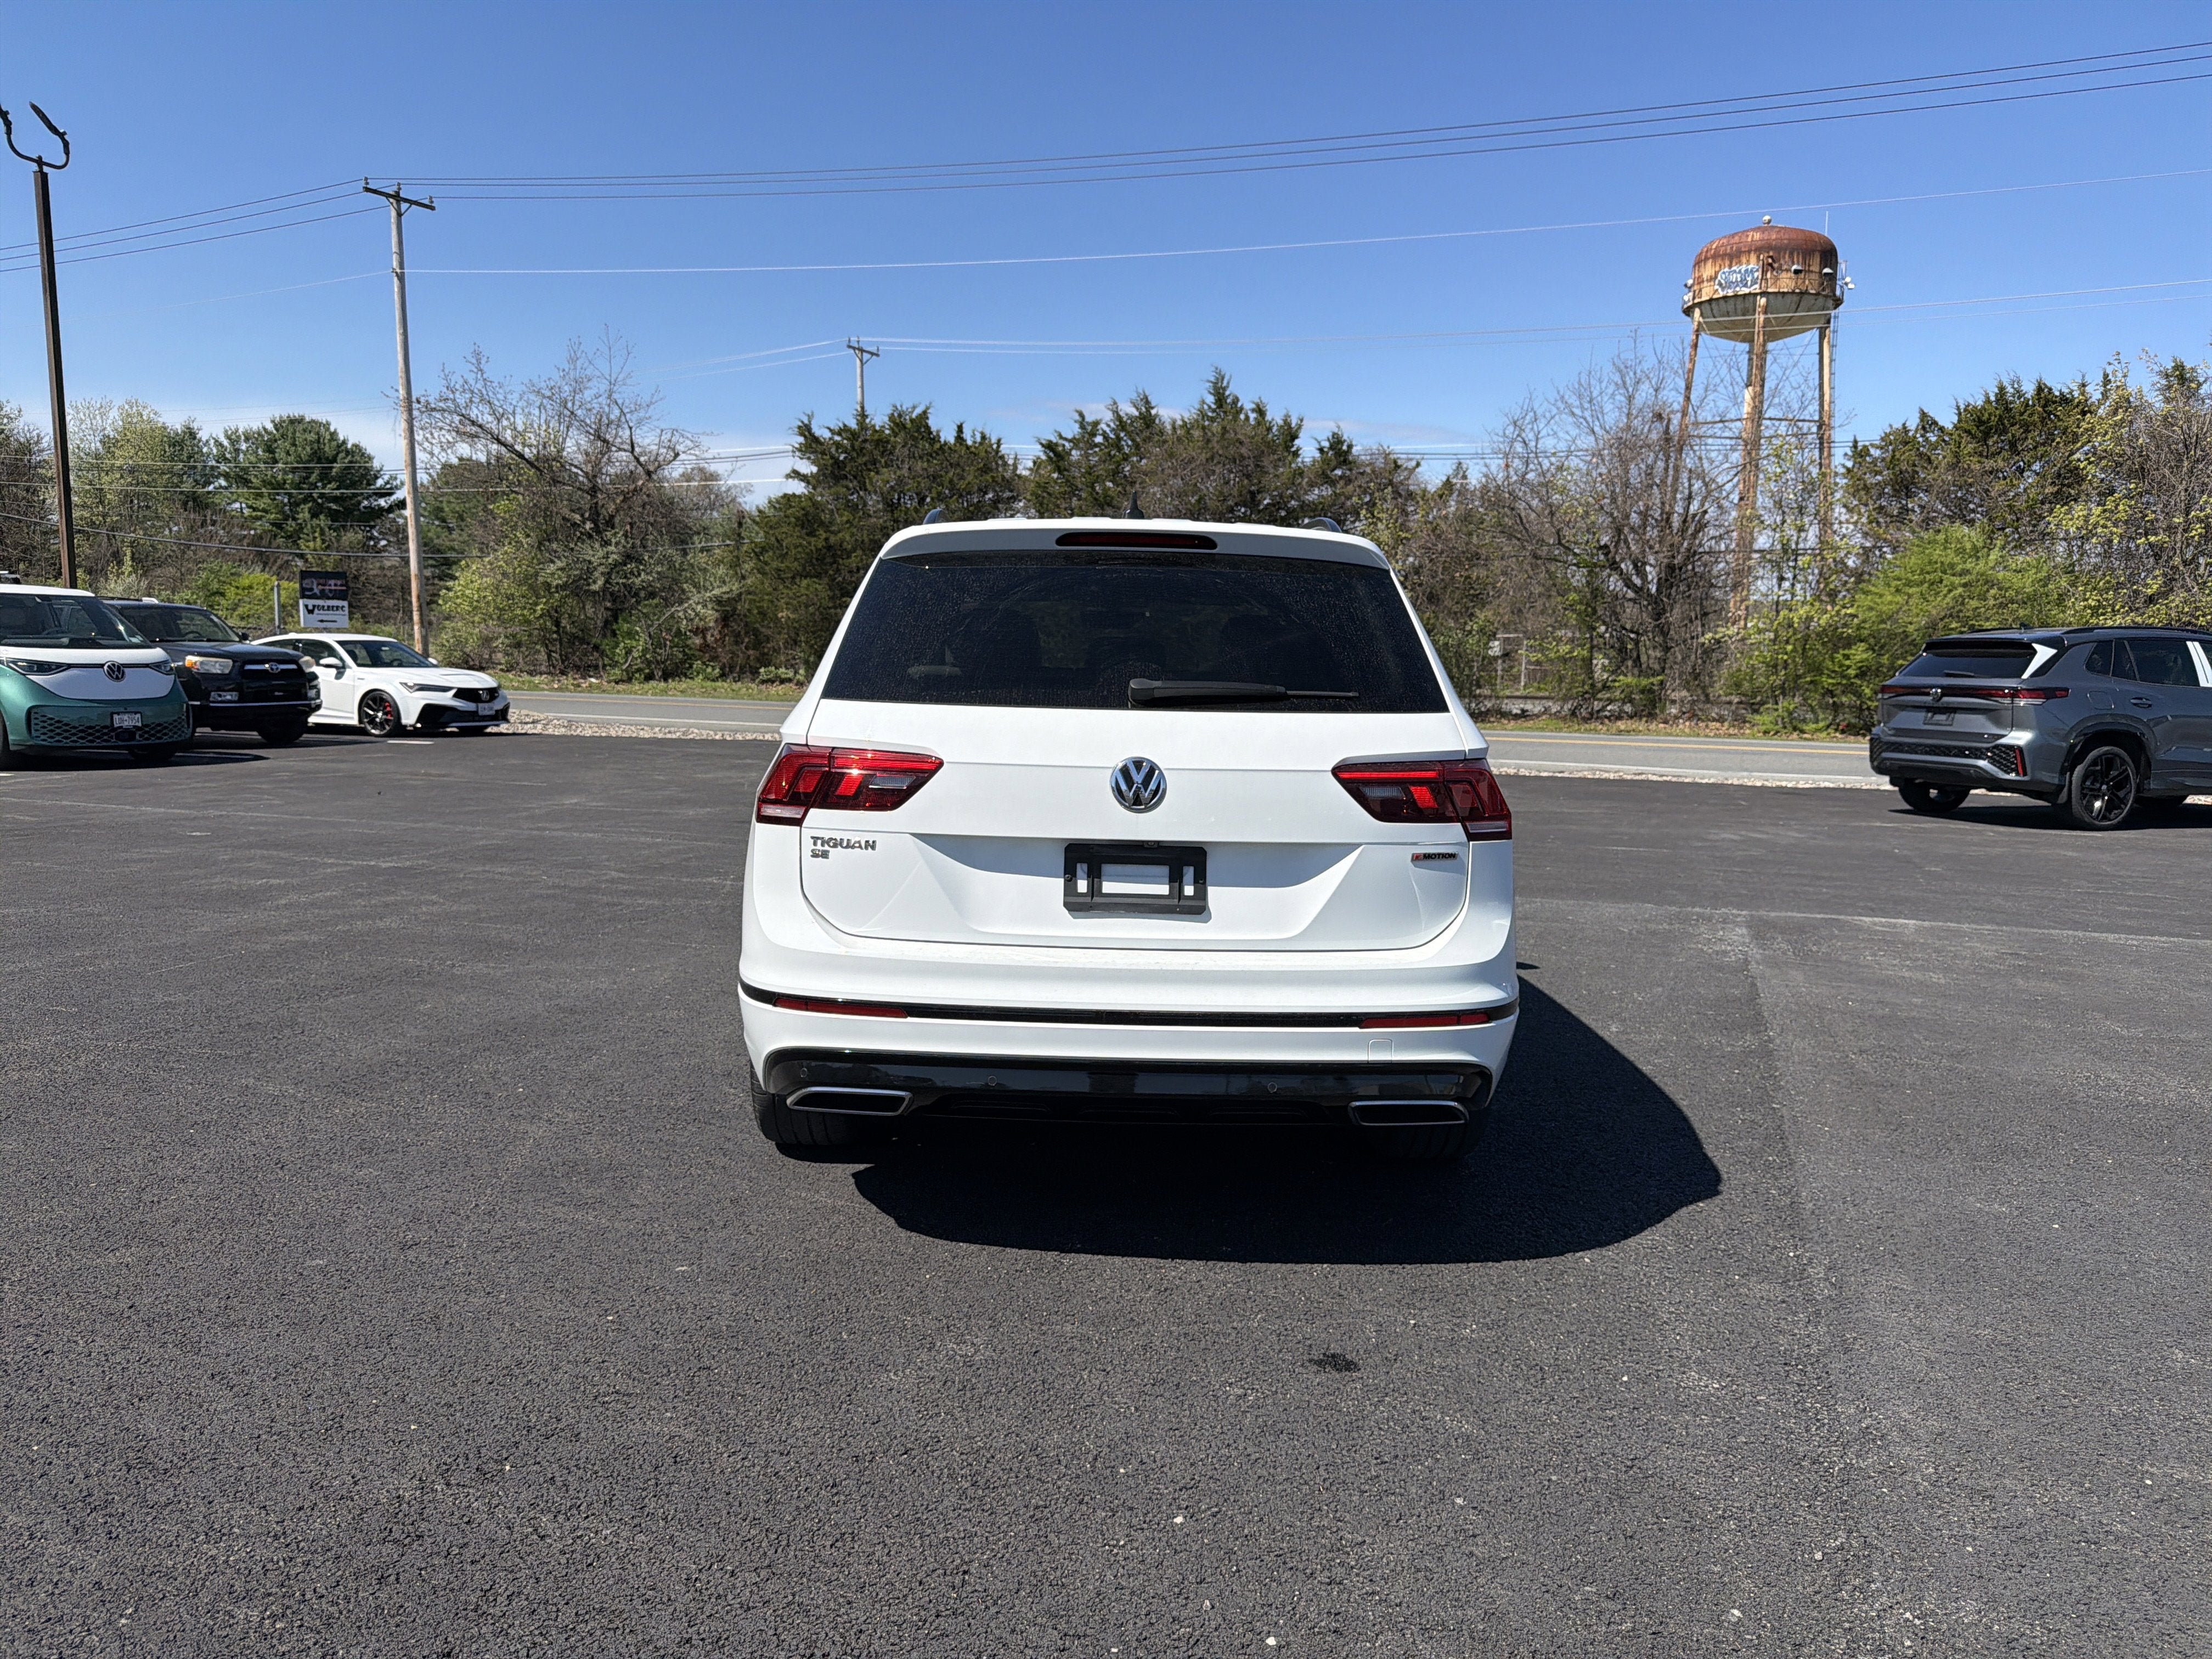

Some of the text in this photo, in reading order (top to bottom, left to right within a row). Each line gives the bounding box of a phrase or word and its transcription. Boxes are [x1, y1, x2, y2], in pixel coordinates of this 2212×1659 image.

[103, 661, 126, 682] VW
[1110, 756, 1167, 814] VW
[810, 836, 877, 851] TIGUAN
[810, 848, 830, 859] SE
